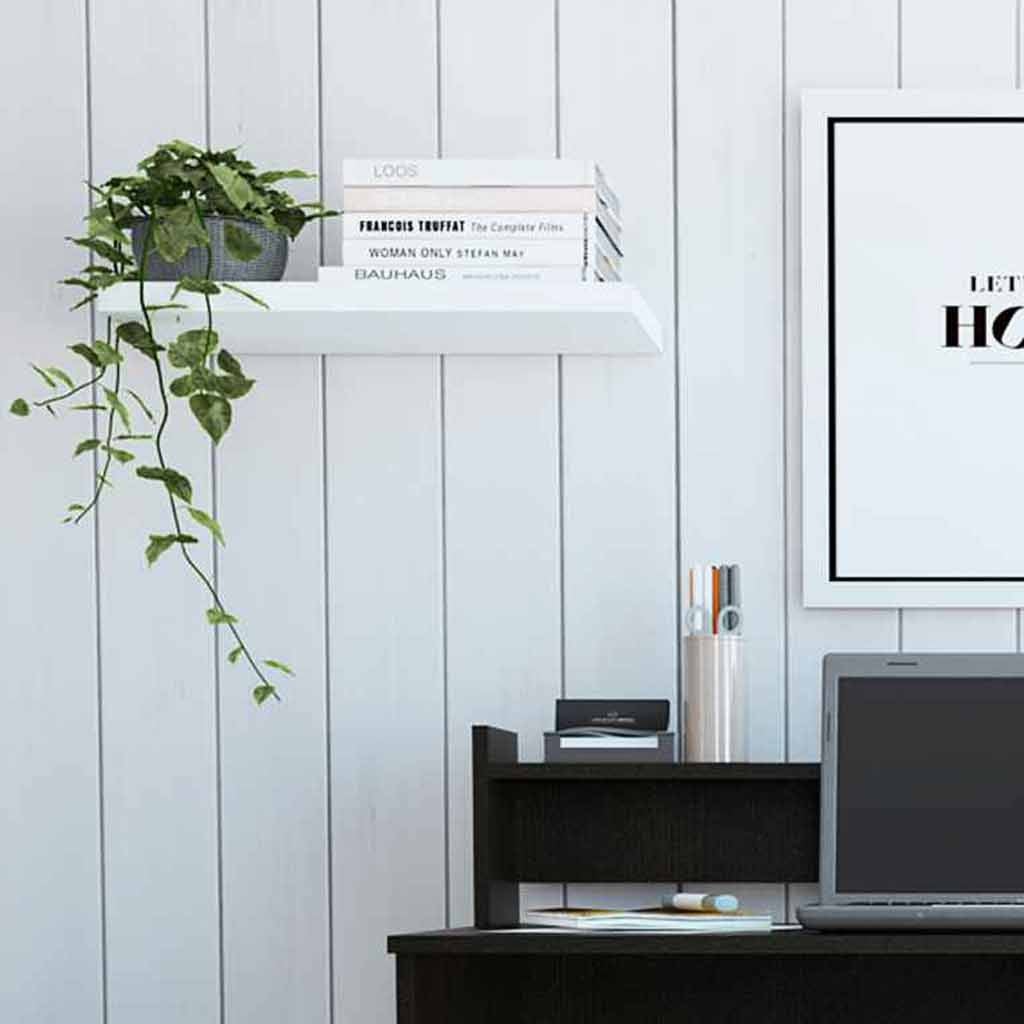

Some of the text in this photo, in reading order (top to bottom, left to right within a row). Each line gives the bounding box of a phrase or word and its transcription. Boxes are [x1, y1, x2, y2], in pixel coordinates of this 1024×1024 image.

[374, 163, 418, 178] LOOS
[359, 220, 414, 232] FRANCOIS
[419, 220, 465, 232] TRUFFAT
[471, 221, 488, 232] The
[490, 221, 535, 233] Complete
[368, 247, 416, 258] WOMAN
[420, 247, 452, 258] ONLY
[457, 248, 498, 258] STEFAN
[354, 268, 447, 281] BAUHAUS
